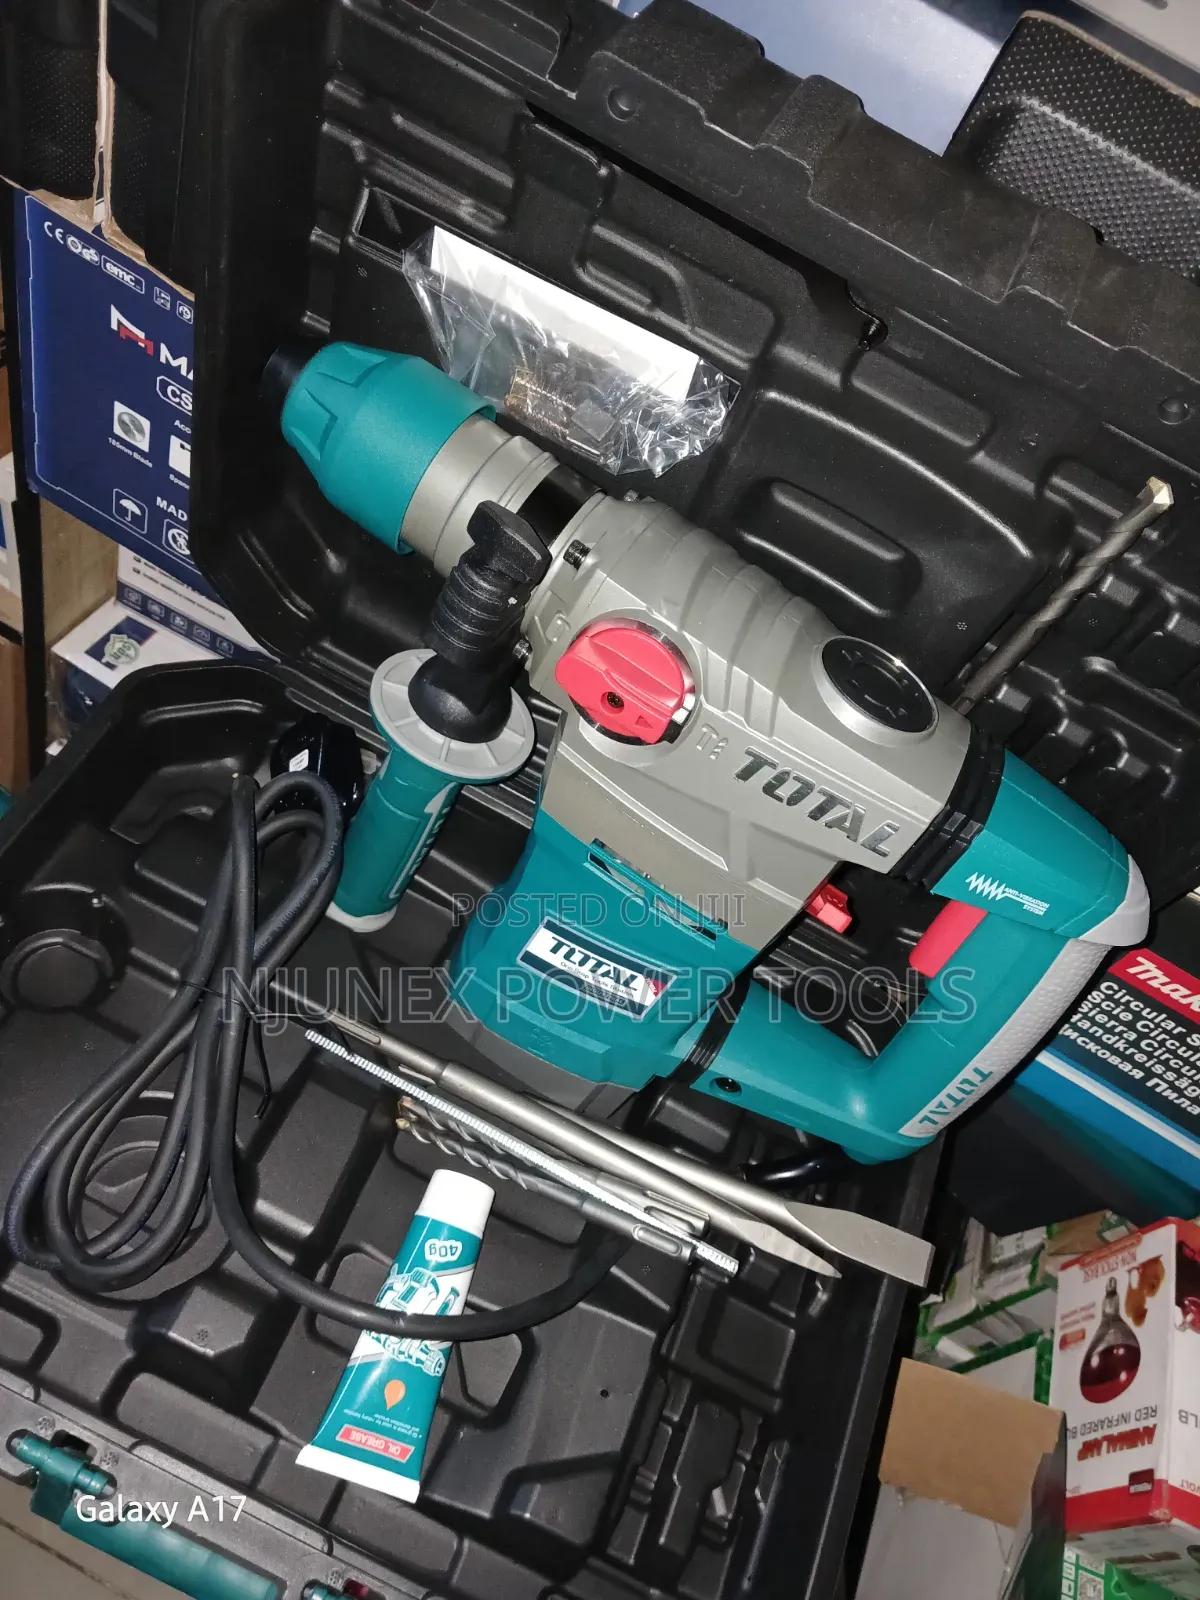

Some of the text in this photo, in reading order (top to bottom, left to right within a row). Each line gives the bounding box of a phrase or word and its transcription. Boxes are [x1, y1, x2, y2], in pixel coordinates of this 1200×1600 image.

[733, 745, 900, 857] TOTAL
[550, 936, 638, 991] TOTAL
[1078, 1001, 1138, 1041] Sierra
[1087, 990, 1133, 1021] Scie
[1100, 981, 1187, 1034] Circular
[918, 1067, 993, 1126] TOTAL
[428, 1242, 459, 1259] 40g
[1080, 1411, 1132, 1436] INFRARED
[1134, 1404, 1158, 1420] RED
[1178, 1409, 1200, 1428] LB
[349, 1430, 401, 1456] OIL GREASE
